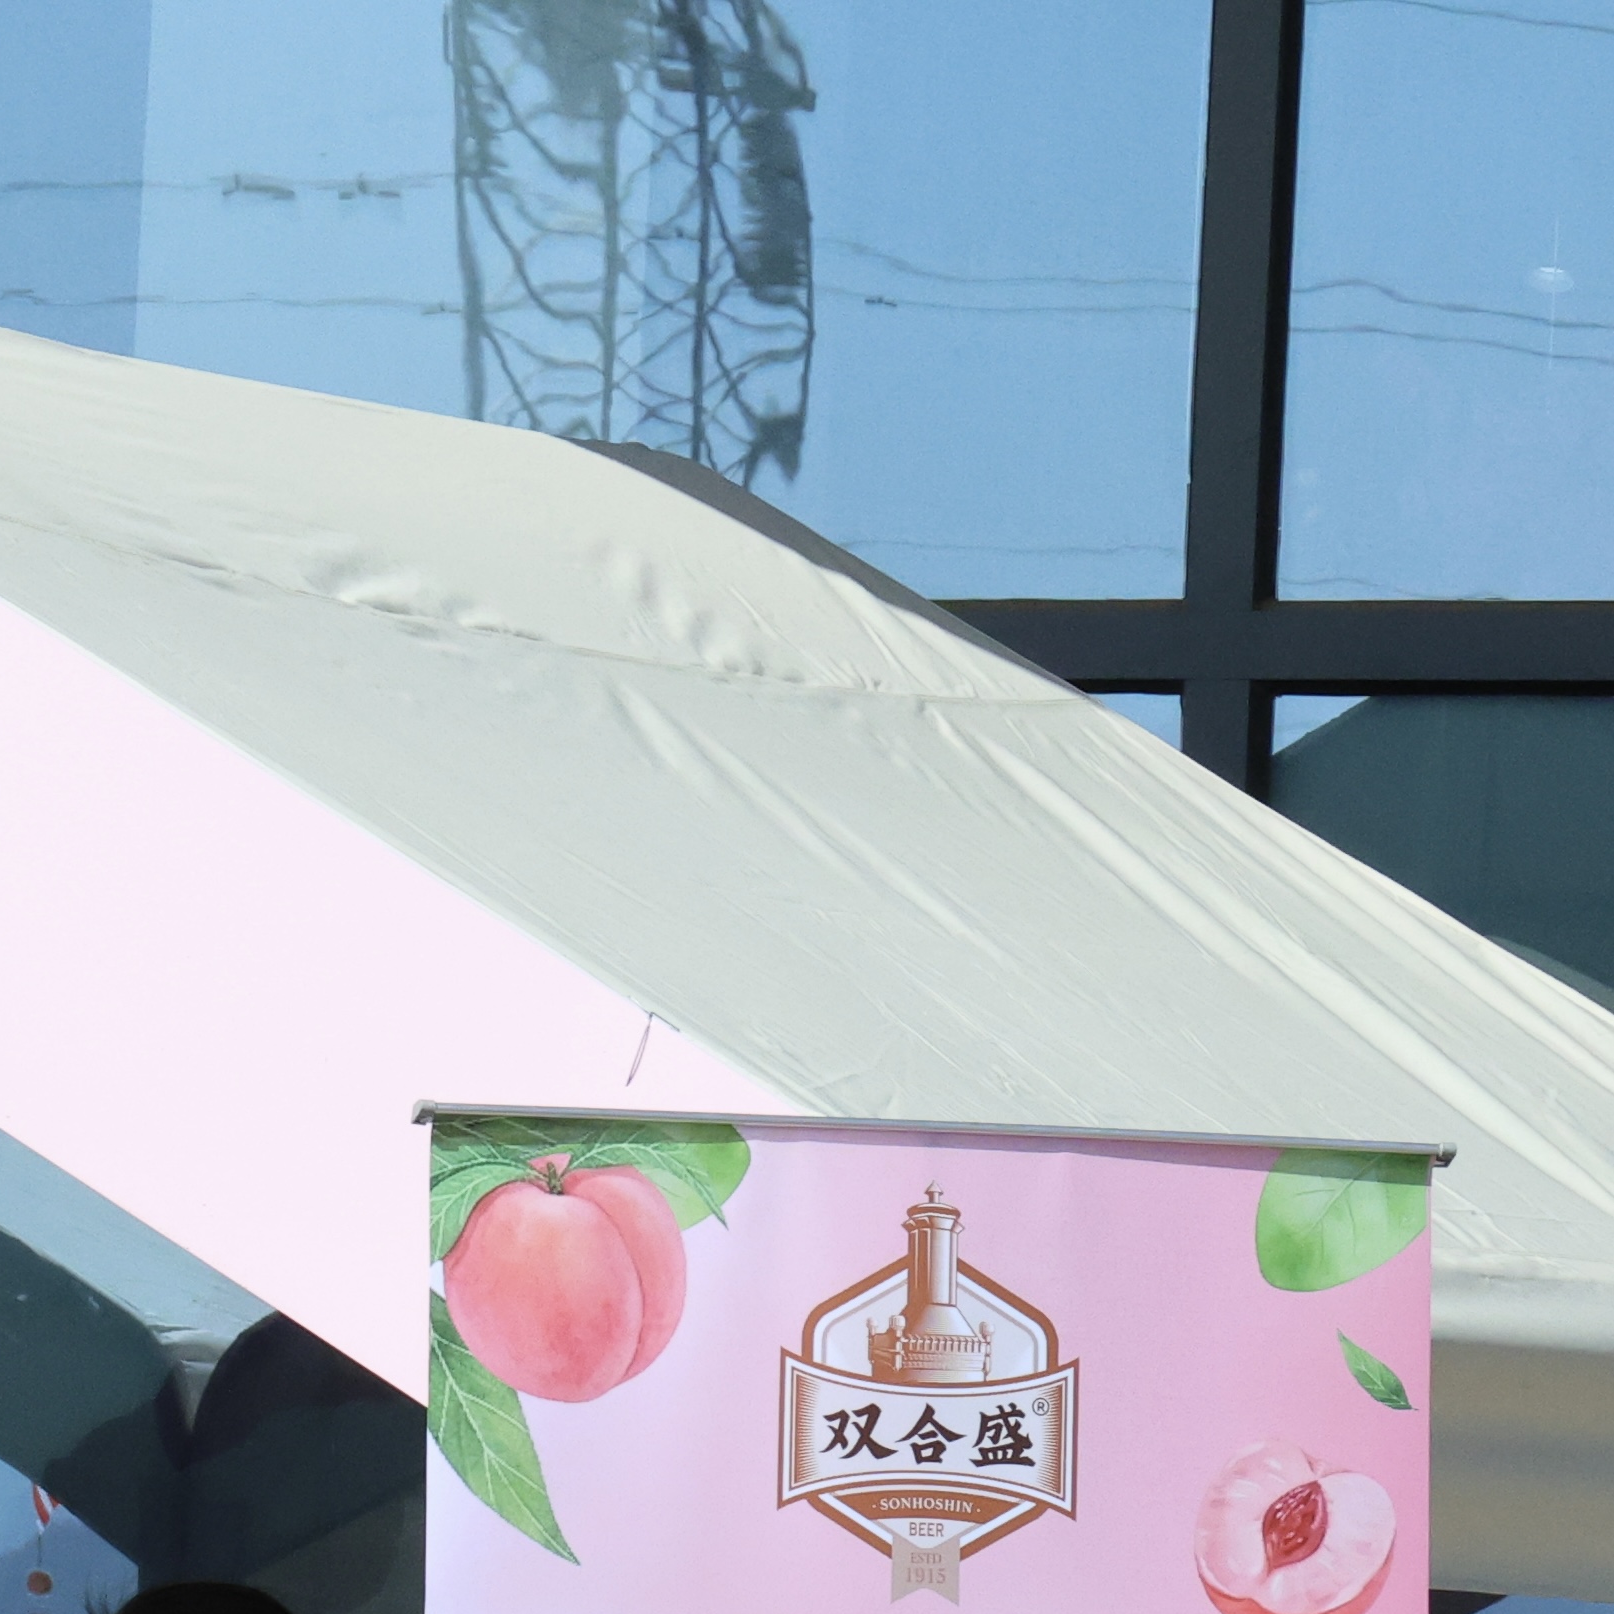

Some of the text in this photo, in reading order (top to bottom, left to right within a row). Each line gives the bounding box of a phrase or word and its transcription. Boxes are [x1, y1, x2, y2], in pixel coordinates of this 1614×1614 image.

[820, 1403, 1036, 1467] 双合盛
[879, 1498, 974, 1514] SONHOSHIN
[908, 1522, 944, 1538] BEER
[905, 1567, 946, 1584] 1915
